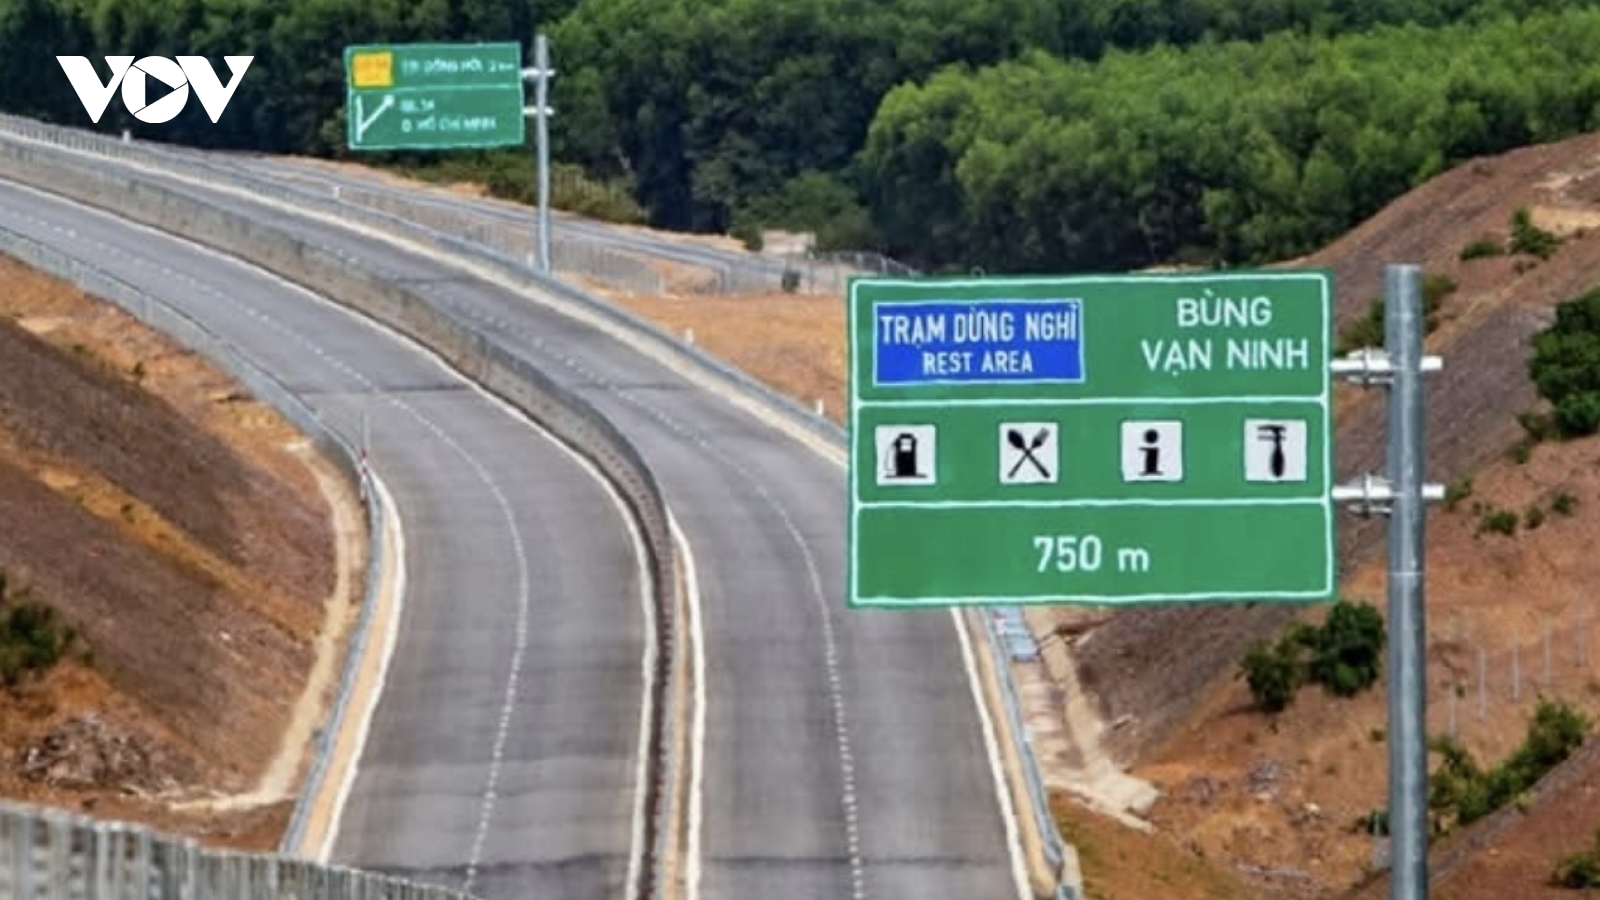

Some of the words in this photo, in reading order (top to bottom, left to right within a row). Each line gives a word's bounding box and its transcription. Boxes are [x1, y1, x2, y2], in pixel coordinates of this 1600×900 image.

[1176, 288, 1272, 327] BÙNG
[880, 313, 945, 350] TRẠM
[922, 351, 973, 376] REST
[981, 350, 1034, 374] AREA
[1141, 337, 1213, 377] VẠN
[1227, 337, 1309, 370] NINH
[1033, 534, 1102, 573] 750
[1117, 548, 1150, 573] m
